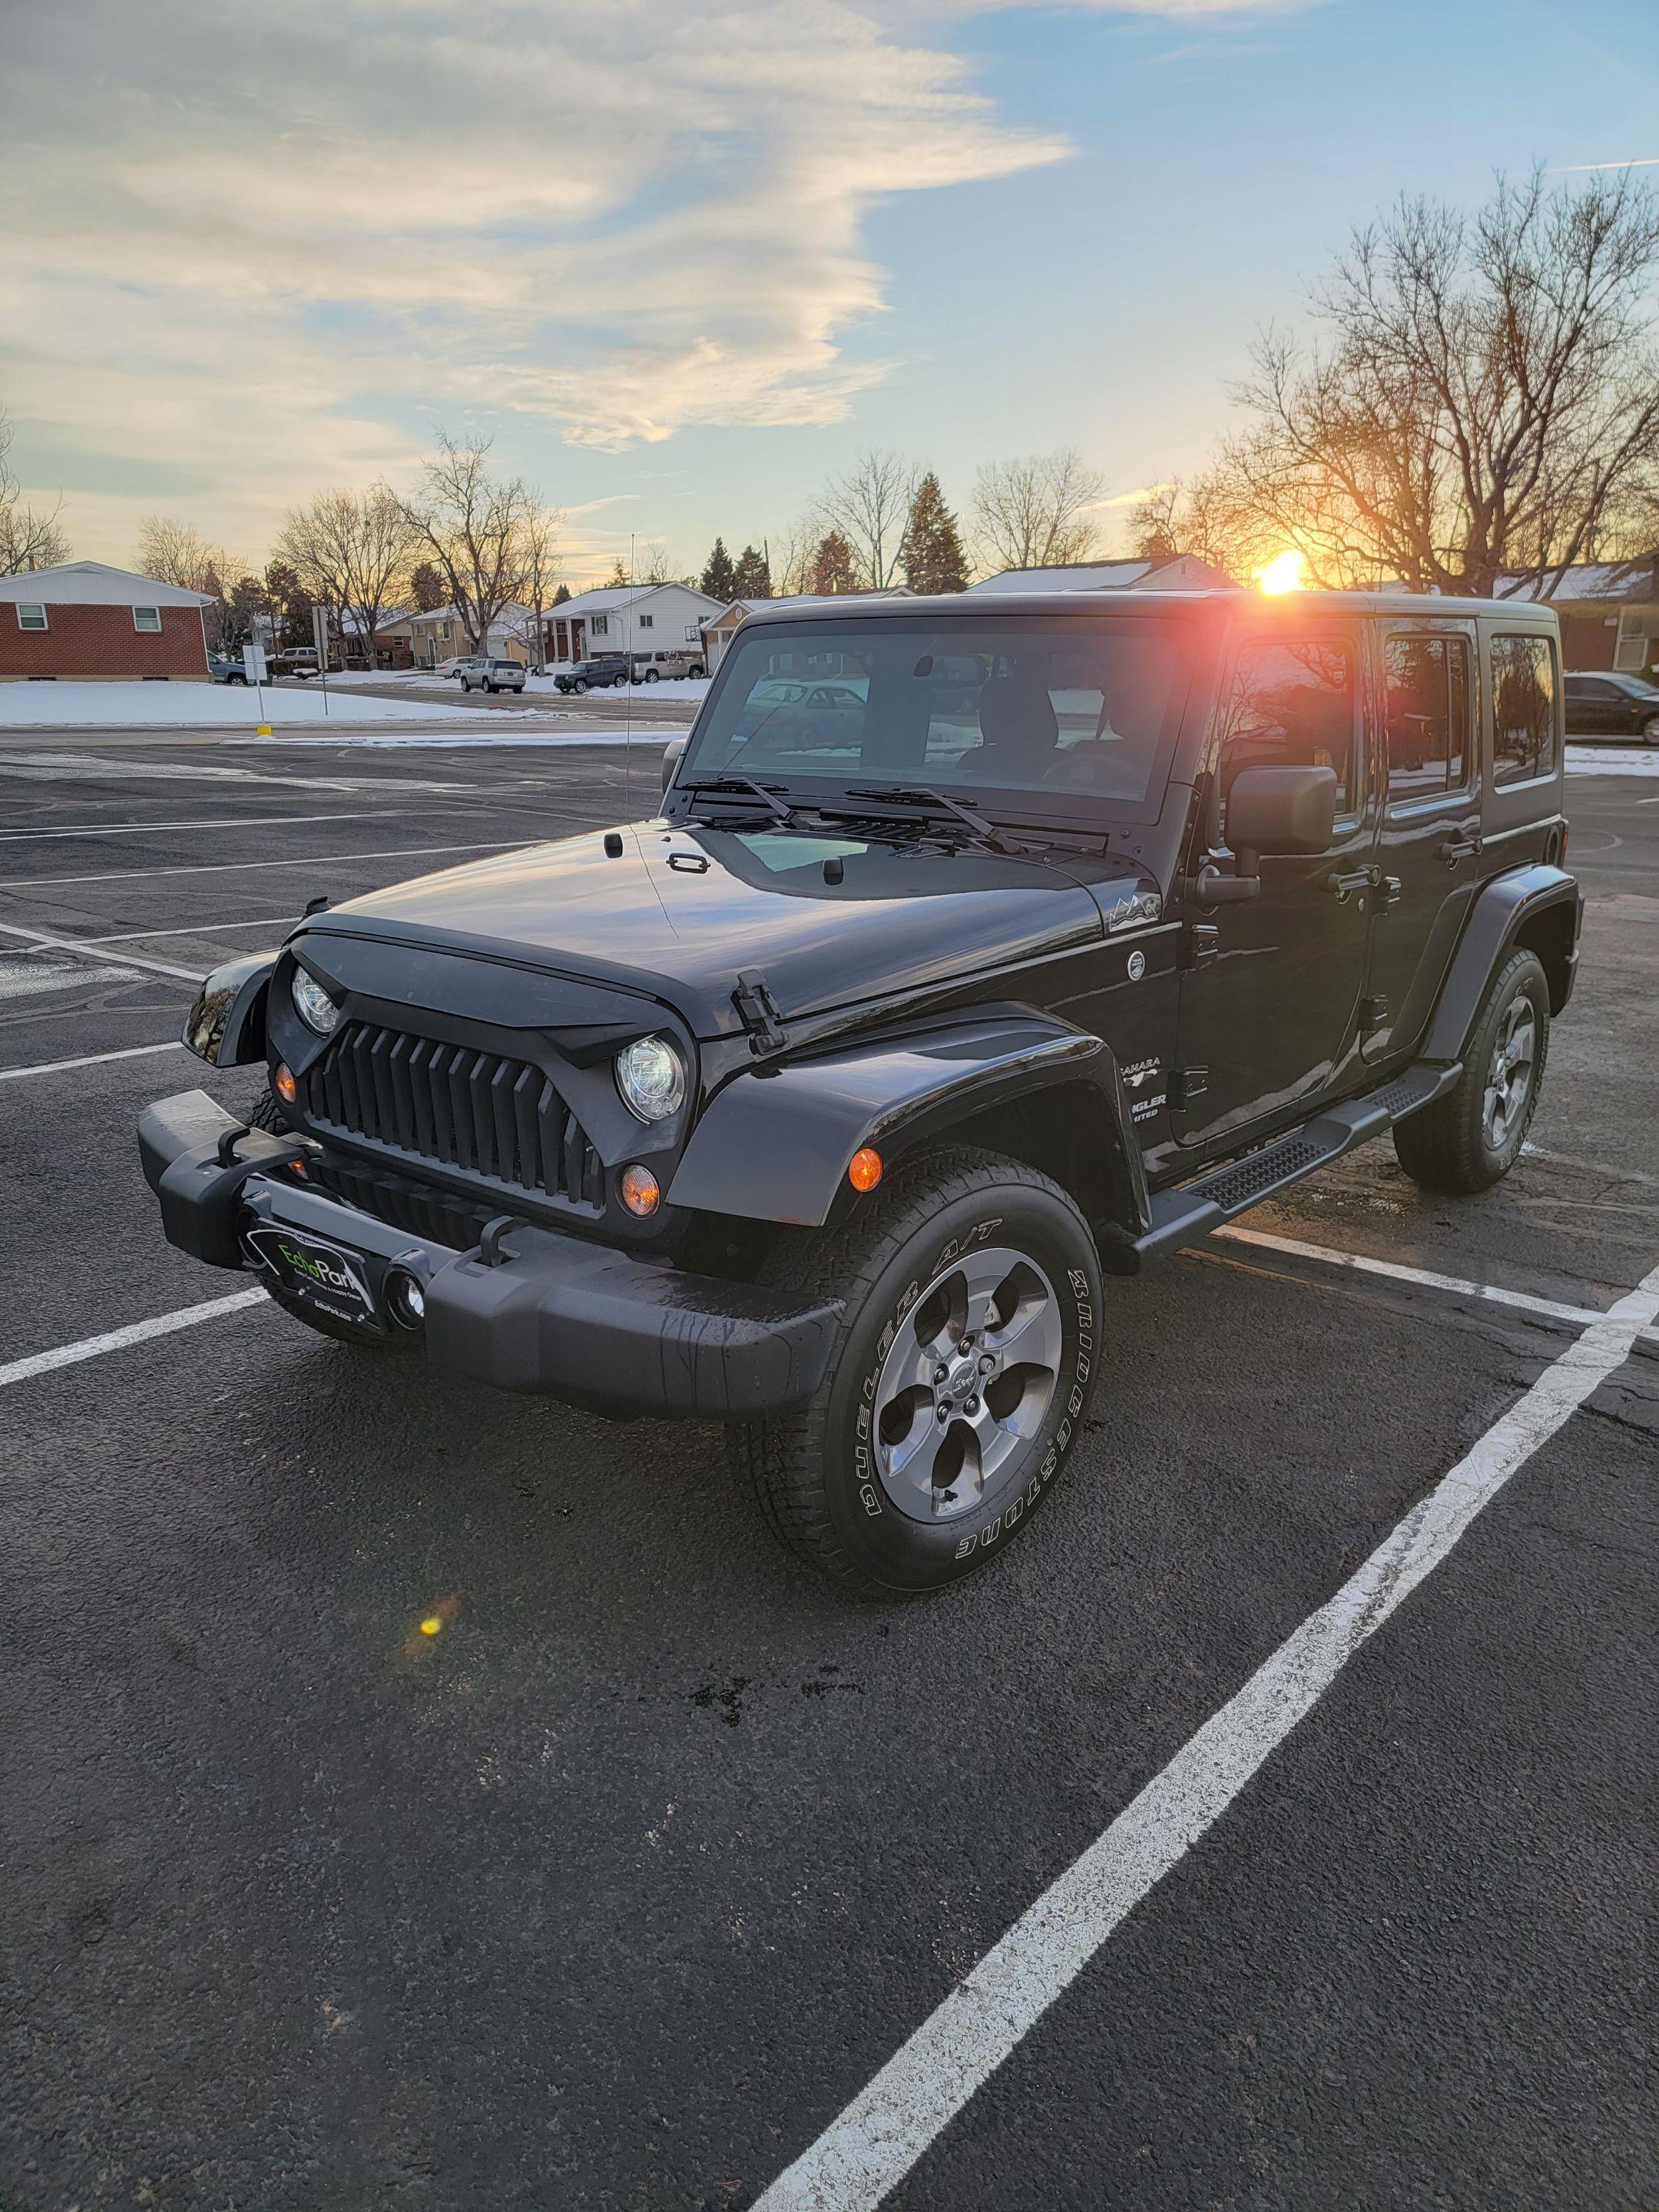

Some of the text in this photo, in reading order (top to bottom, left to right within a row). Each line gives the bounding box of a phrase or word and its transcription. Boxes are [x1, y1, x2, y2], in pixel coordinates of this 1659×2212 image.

[278, 1243, 357, 1290] EchoPark
[855, 1217, 1003, 1516] DUELER A/T
[954, 1269, 1093, 1560] BRIDGESTONE
